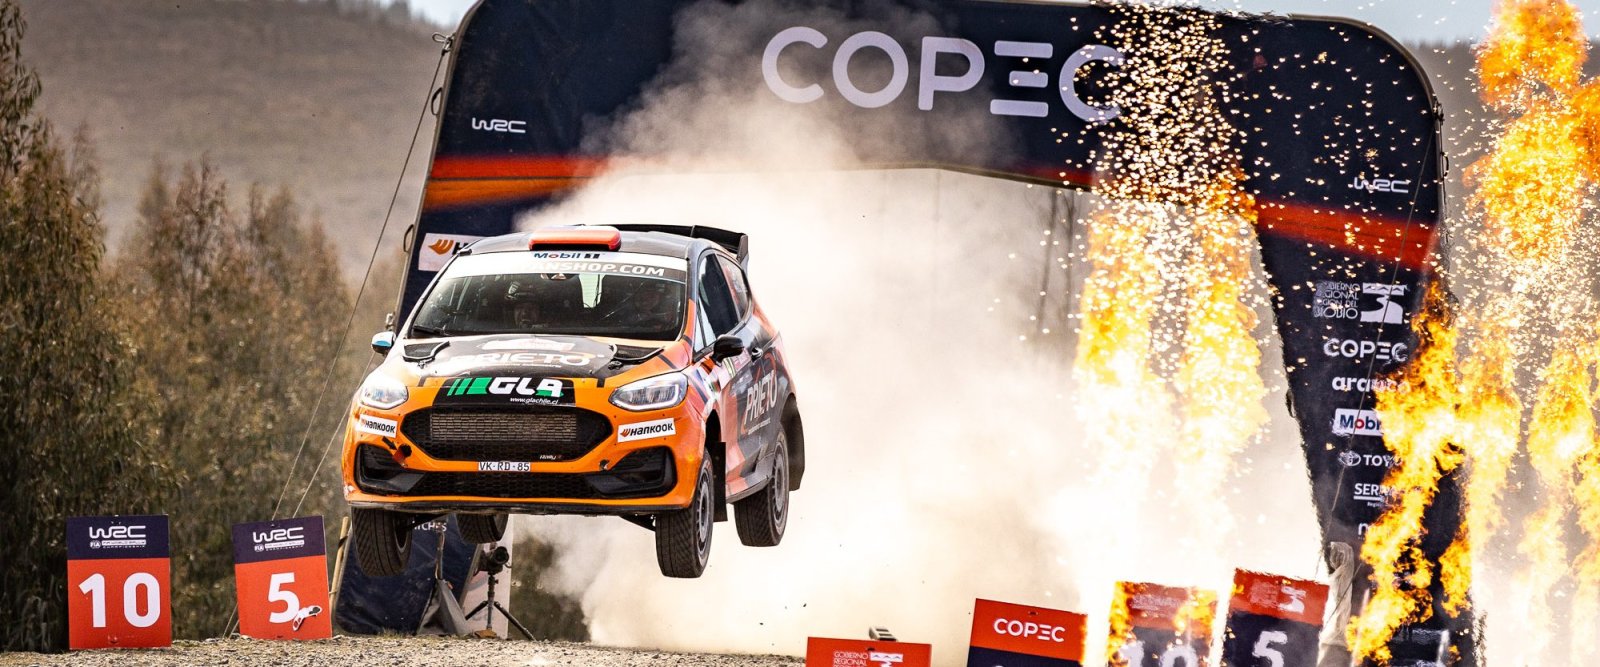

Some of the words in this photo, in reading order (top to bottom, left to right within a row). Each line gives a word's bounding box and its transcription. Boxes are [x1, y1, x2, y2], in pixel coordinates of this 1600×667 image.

[761, 26, 1125, 125] COPEC
[471, 117, 527, 133] WRC
[1353, 177, 1409, 194] WRC
[533, 261, 665, 276] ANSHOP.COM
[1323, 338, 1409, 362] COPEC
[89, 525, 146, 539] WRC
[253, 527, 304, 543] WRC
[78, 571, 161, 629] 10
[267, 572, 301, 624] 5
[993, 618, 1066, 643] COPEC
